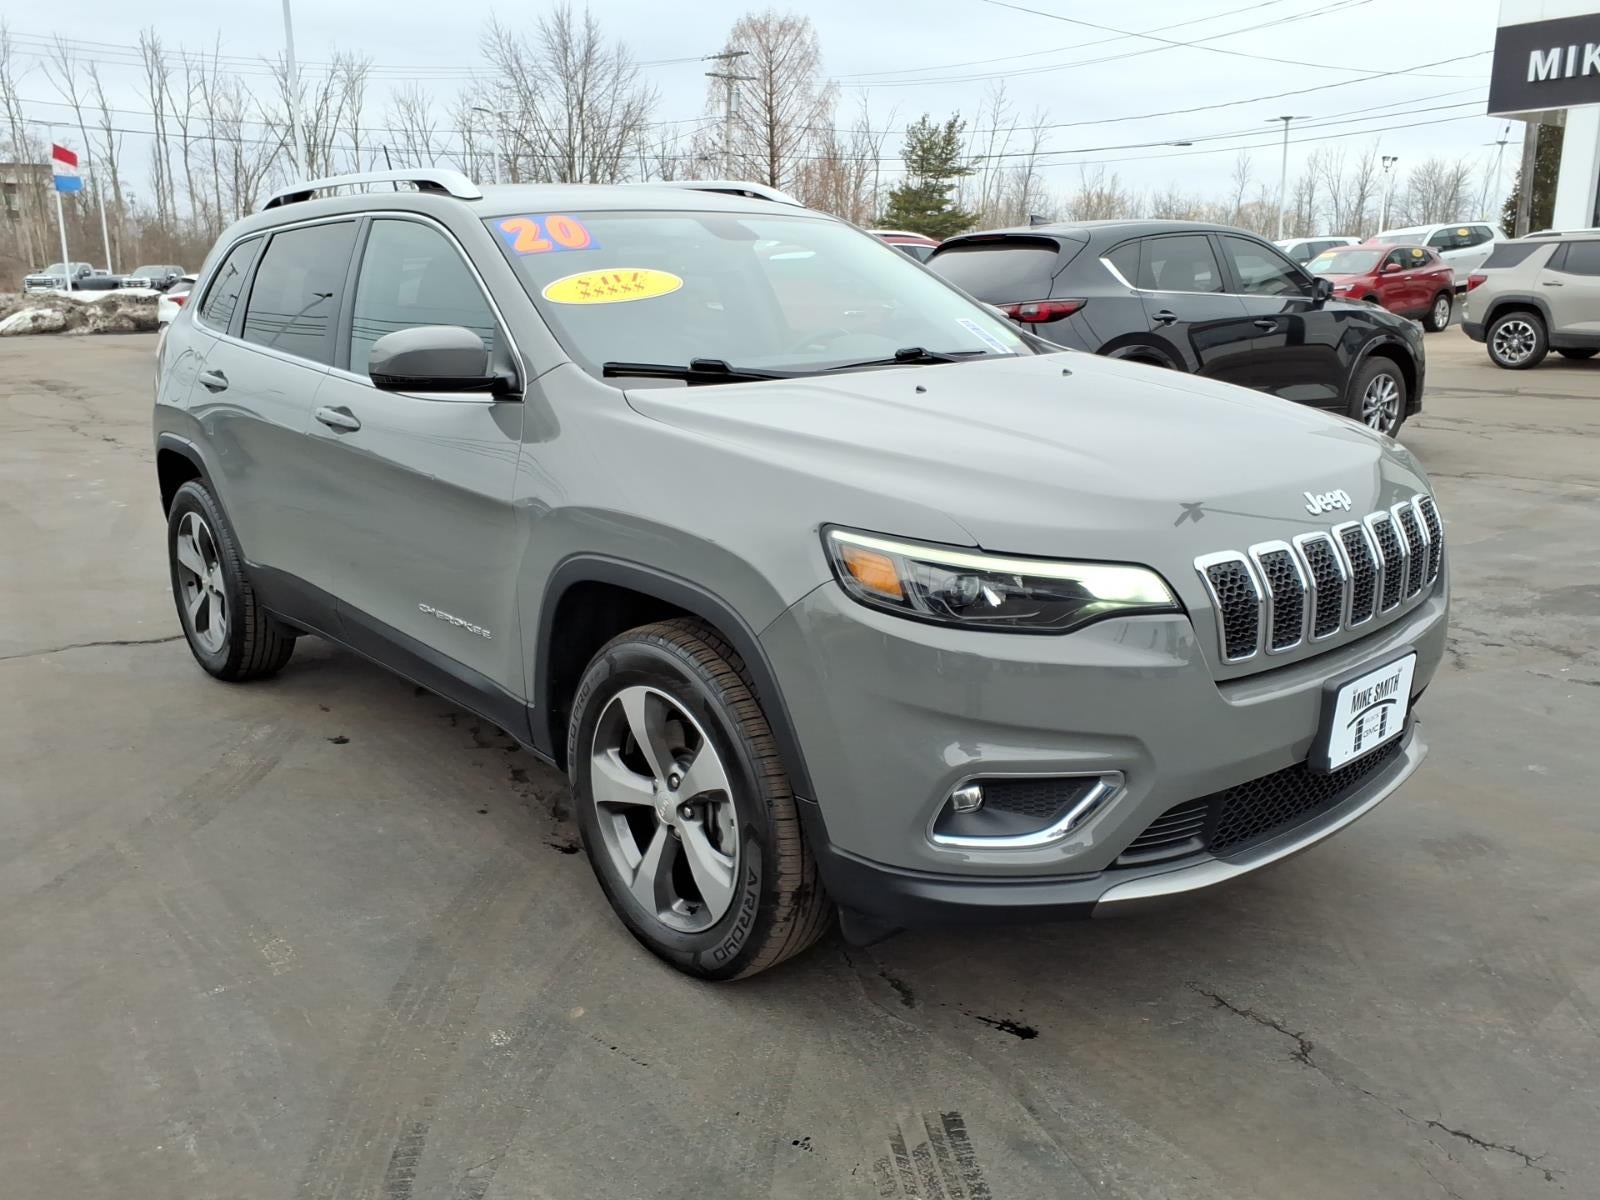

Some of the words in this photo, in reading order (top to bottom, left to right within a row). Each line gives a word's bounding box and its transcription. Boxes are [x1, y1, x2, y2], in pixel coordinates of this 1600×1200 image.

[501, 215, 590, 252] 20
[1303, 488, 1352, 516] Jeep
[418, 603, 492, 640] CHEROKEE
[1350, 686, 1373, 714] MIKE
[1373, 673, 1400, 702] SMITH
[713, 865, 758, 962] ARROYO
